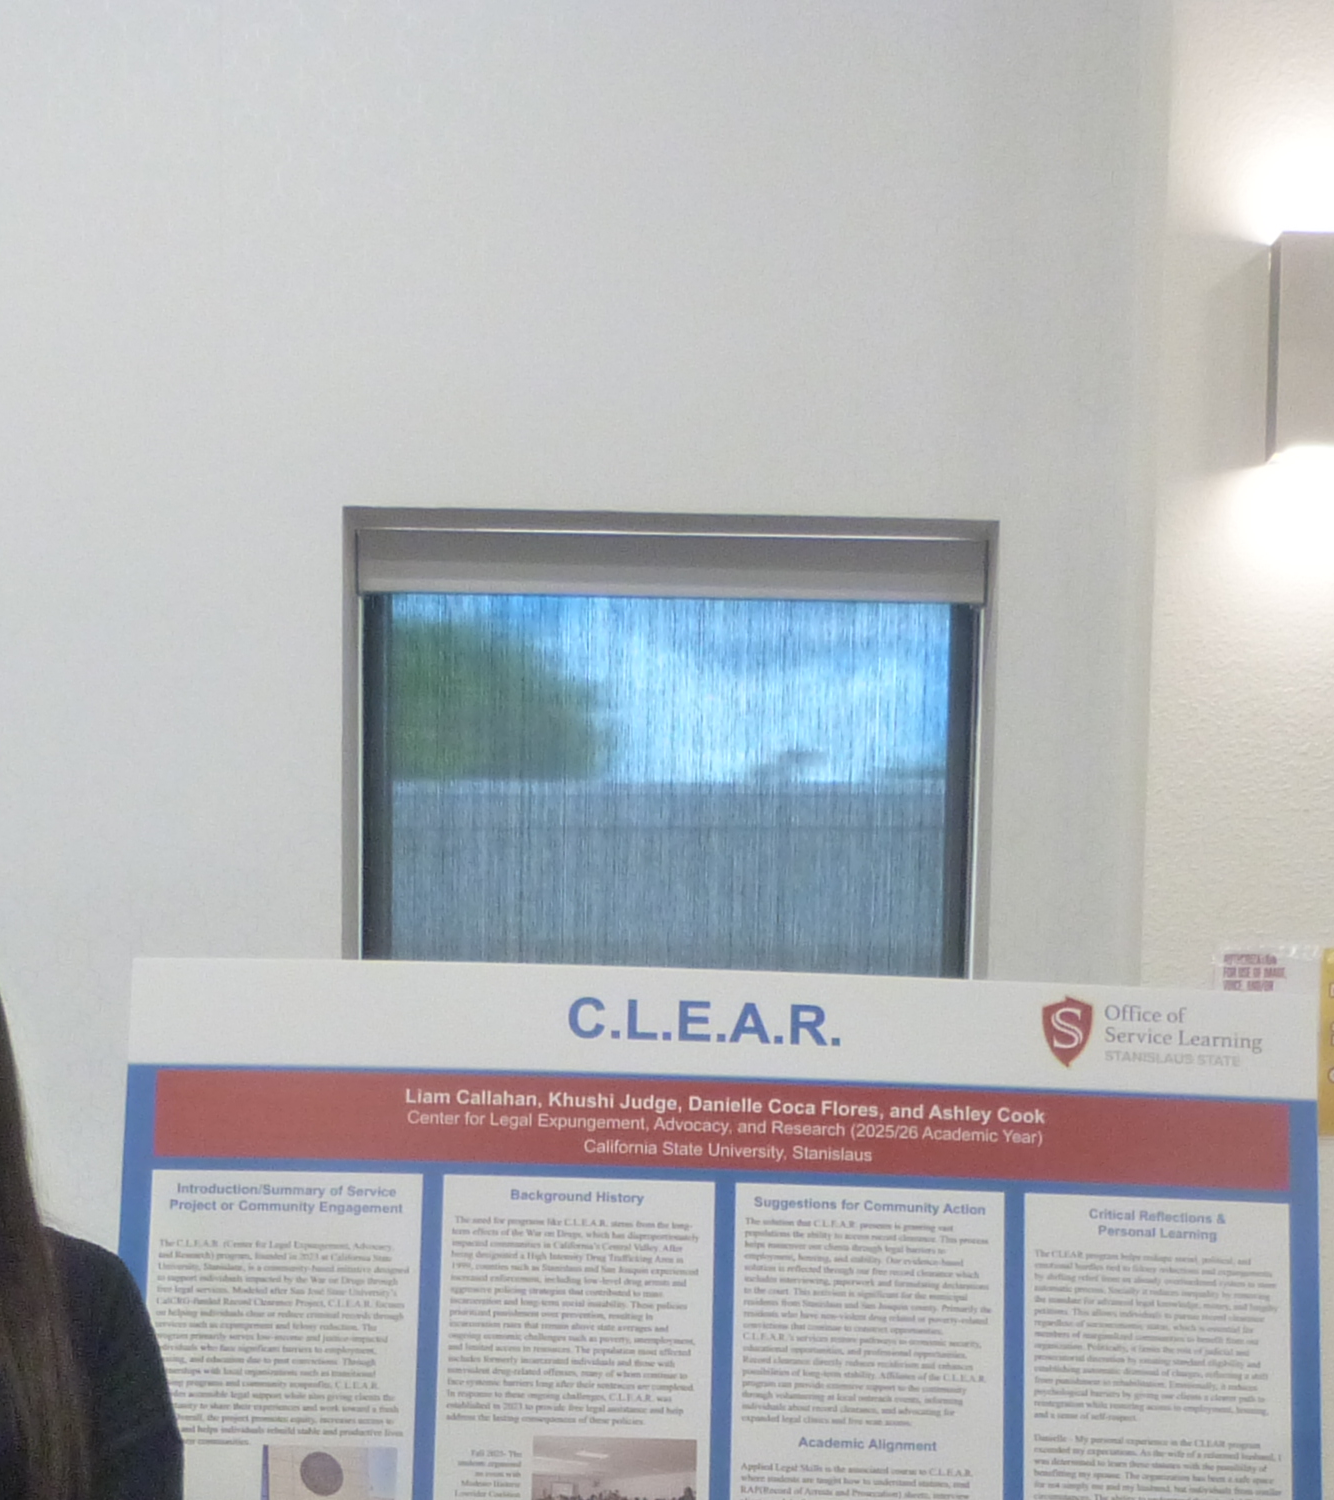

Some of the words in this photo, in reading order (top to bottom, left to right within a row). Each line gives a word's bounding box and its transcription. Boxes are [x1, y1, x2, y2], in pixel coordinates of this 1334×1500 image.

[568, 996, 842, 1047] C.L.E.A.R.
[1105, 1004, 1162, 1022] Office
[1167, 1007, 1186, 1024] of
[1104, 1027, 1173, 1045] Service
[1179, 1030, 1262, 1054] Learning
[1105, 1050, 1194, 1065] STANISLAUS
[1197, 1055, 1241, 1067] STATE
[406, 1087, 452, 1103] Liam
[457, 1089, 543, 1109] Callahan,
[548, 1092, 615, 1109] Khushi
[620, 1094, 683, 1115] Judge,
[688, 1096, 763, 1114] Danielle
[768, 1099, 816, 1115] Coca
[821, 1101, 885, 1120] Flores,
[890, 1103, 925, 1119] and
[929, 1104, 994, 1125] Ashley
[998, 1106, 1047, 1123] Cook
[408, 1110, 461, 1124] Center
[465, 1111, 486, 1125] for
[490, 1112, 533, 1130] Legal
[537, 1114, 650, 1134] Expungement,
[654, 1117, 734, 1136] Advocacy,
[737, 1120, 767, 1134] and
[771, 1121, 846, 1137] Research
[850, 1124, 919, 1142] (2025/26
[923, 1126, 1000, 1142] Academic
[1003, 1129, 1045, 1146] Year)
[584, 1139, 658, 1155] California
[662, 1142, 703, 1156] State
[708, 1143, 788, 1162] University,
[792, 1146, 873, 1162] Stanislaus
[177, 1183, 326, 1198] Introduction/Summary
[330, 1186, 343, 1196] of
[347, 1186, 397, 1197] Service
[510, 1189, 593, 1205] Background
[596, 1192, 645, 1206] History
[169, 1199, 217, 1213] Project
[220, 1202, 235, 1211] or
[238, 1200, 316, 1215] Community
[319, 1202, 403, 1216] Engagement
[754, 1196, 838, 1212] Suggestions
[841, 1200, 860, 1210] for
[863, 1200, 940, 1216] Community
[943, 1203, 987, 1215] Action
[1089, 1208, 1136, 1220] Critical
[1139, 1210, 1213, 1224] Reflections
[1216, 1214, 1227, 1224] &
[1098, 1225, 1156, 1238] Personal
[1160, 1228, 1218, 1243] Learning
[798, 1437, 865, 1449] Academic
[869, 1439, 938, 1454] Alignment
